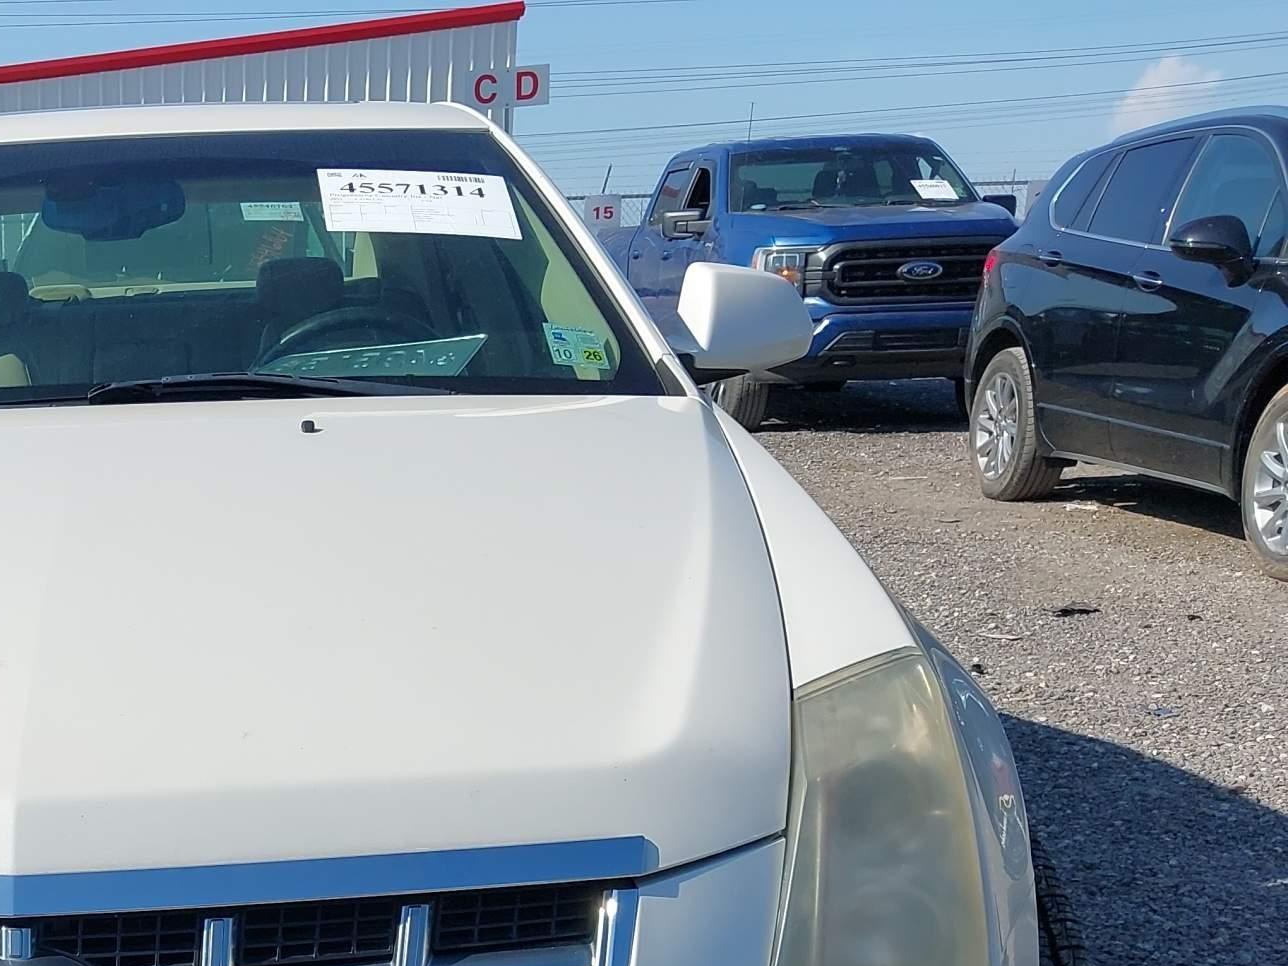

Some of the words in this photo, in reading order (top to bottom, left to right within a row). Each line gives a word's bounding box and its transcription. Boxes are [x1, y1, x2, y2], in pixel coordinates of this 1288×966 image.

[474, 73, 497, 105] C
[516, 71, 539, 101] D
[340, 181, 487, 199] 45571314
[593, 206, 614, 220] 15
[554, 348, 572, 360] 10
[583, 350, 603, 362] 26
